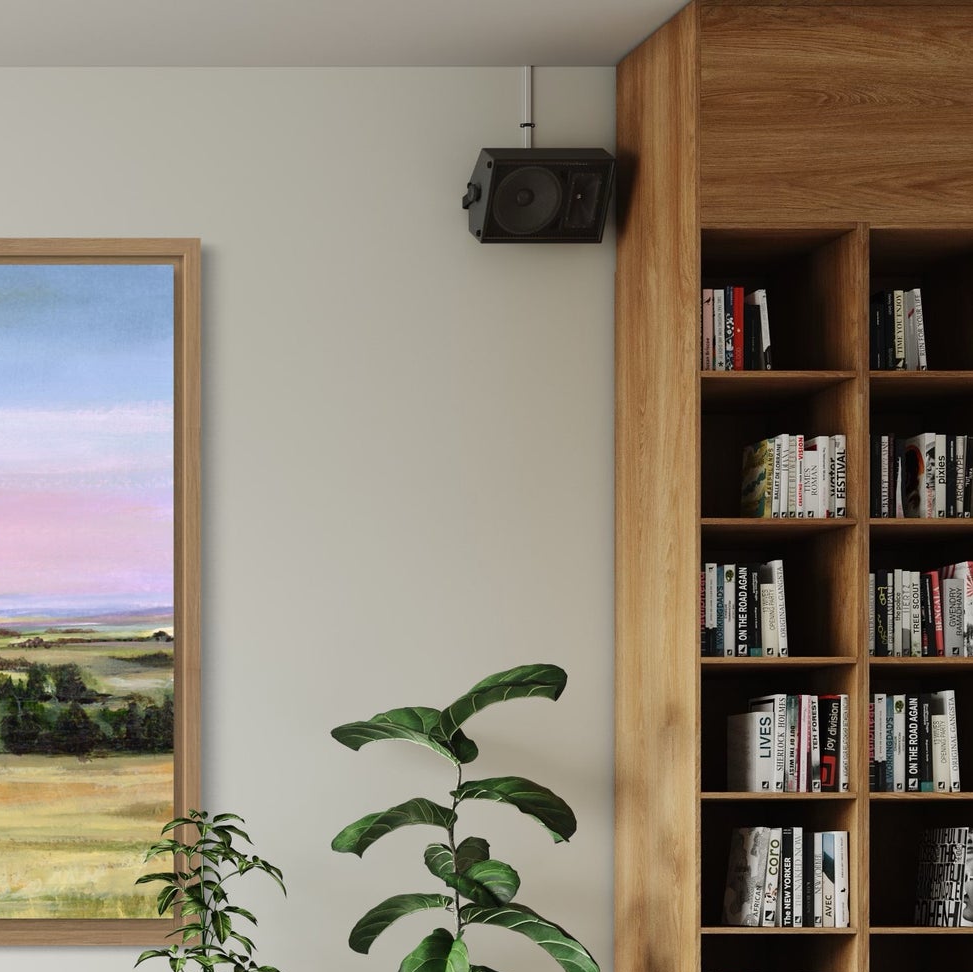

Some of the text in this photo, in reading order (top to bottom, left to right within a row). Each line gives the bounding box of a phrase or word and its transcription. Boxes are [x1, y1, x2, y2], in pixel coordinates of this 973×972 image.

[895, 294, 904, 354] TIME YOU ENJOY
[836, 449, 846, 499] FESTIVAL
[936, 455, 946, 484] pixies
[738, 567, 747, 641] ON THE ROAD AGAIN
[776, 566, 786, 638] ORIGINAL GANGSTA
[894, 592, 902, 610] police
[932, 586, 943, 631] BENGALA
[716, 609, 724, 647] WORKING
[776, 697, 786, 771] SHERLOCK HOLMES
[824, 702, 839, 751] joy division
[948, 697, 956, 732] GANGSTA
[759, 717, 771, 758] LIVES
[789, 738, 795, 746] OF
[886, 716, 894, 779] WORKING DAD'S
[909, 697, 918, 774] ON THE ROAD AGAIN
[768, 839, 779, 876] coro
[794, 835, 802, 857] NOW
[794, 859, 802, 891] NAKED
[752, 885, 762, 918] AFRICAN
